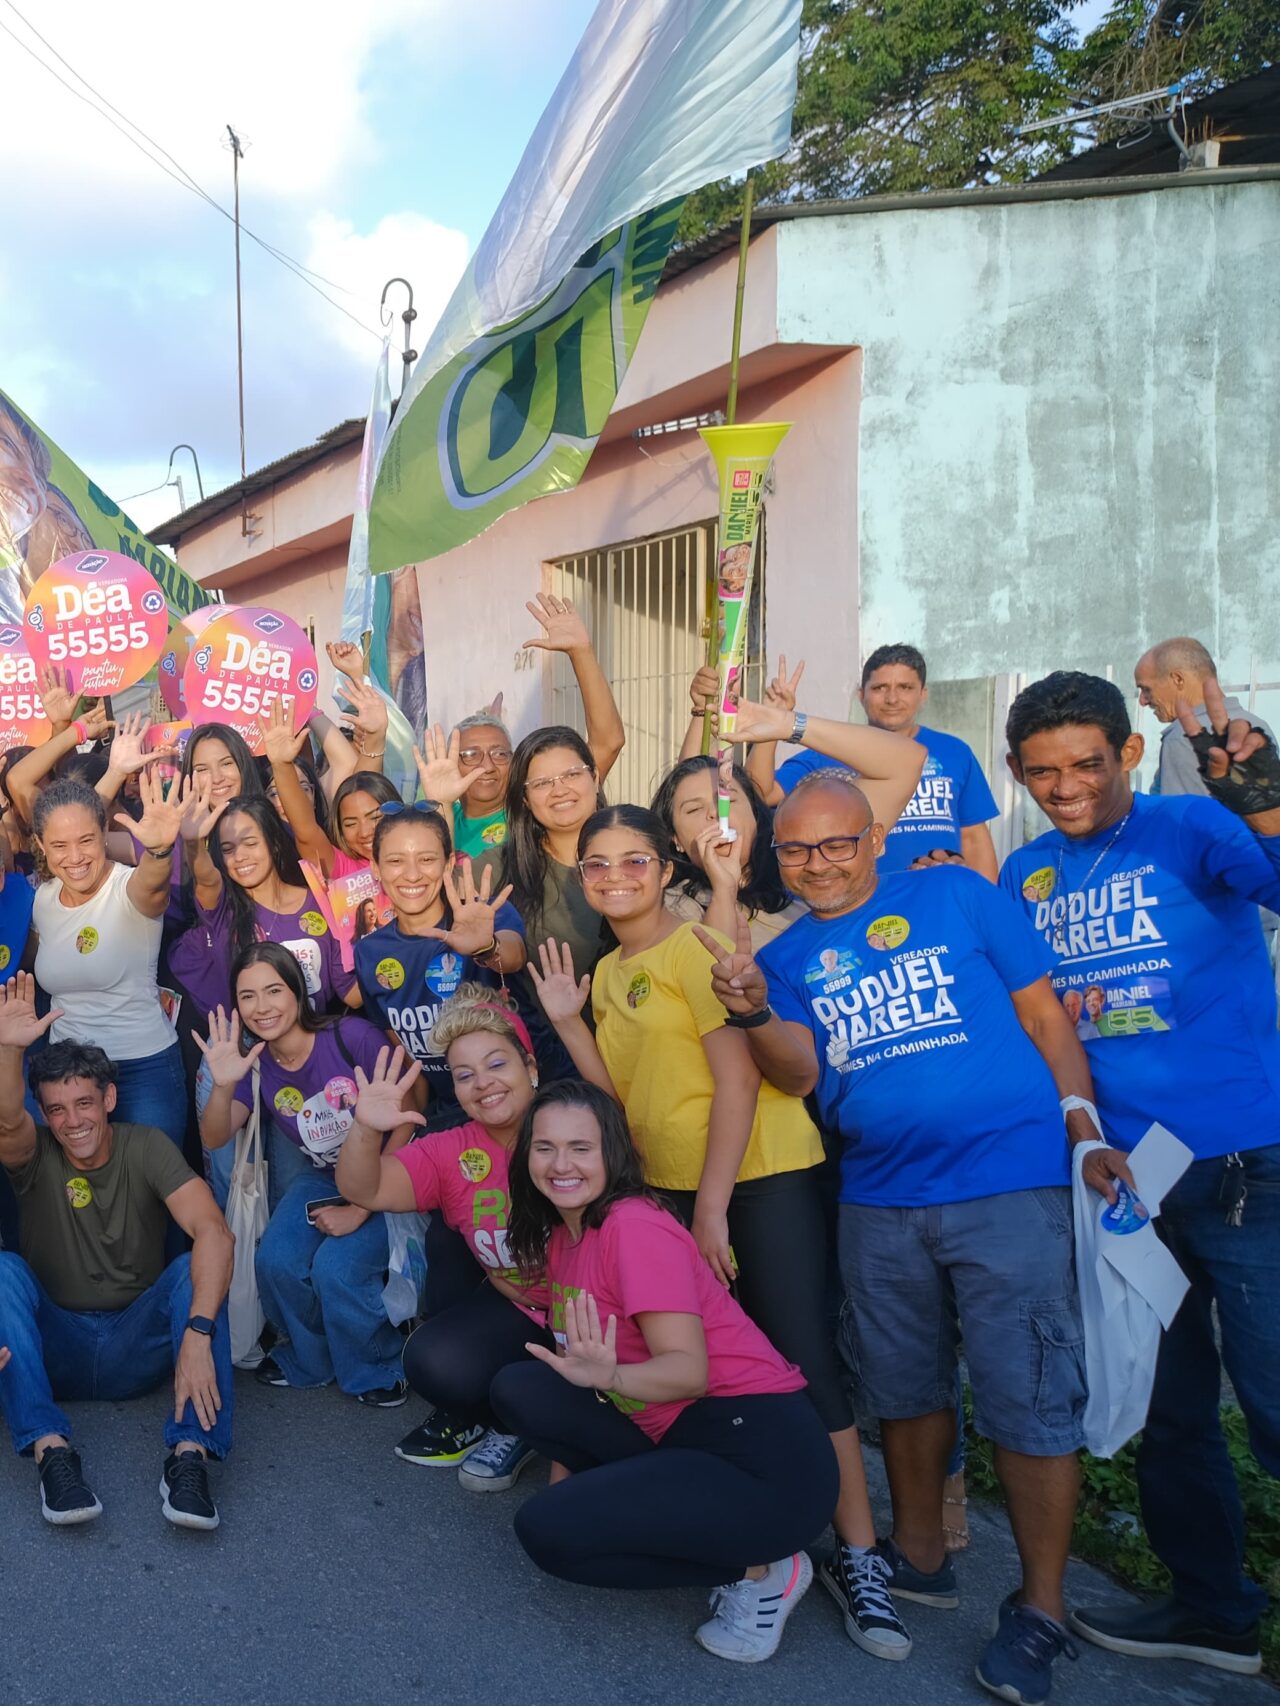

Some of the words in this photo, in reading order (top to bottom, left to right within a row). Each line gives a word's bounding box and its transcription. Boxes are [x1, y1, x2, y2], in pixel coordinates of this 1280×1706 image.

[52, 581, 133, 622] Déa
[57, 621, 73, 630] DE
[85, 612, 134, 626] PAULA
[48, 621, 149, 661] 55555
[220, 633, 291, 681] Déa
[219, 670, 235, 679] DE
[246, 675, 288, 690] PAULA
[912, 780, 953, 799] UEL
[901, 798, 952, 817] RELA
[346, 873, 373, 892] Déa
[346, 885, 380, 907] 55555
[1035, 876, 1158, 930] DODUEL
[890, 944, 949, 965] VEREADOR
[1069, 975, 1084, 986] NA
[1086, 958, 1172, 983] CAMINHADA
[811, 955, 955, 1026] DODUEL
[823, 975, 852, 995] 55999
[1107, 985, 1152, 1003] DANIEL
[387, 1004, 441, 1031] DOD
[1108, 1005, 1155, 1031] 55
[866, 1052, 881, 1065] NA
[883, 1032, 968, 1058] CAMINHADA
